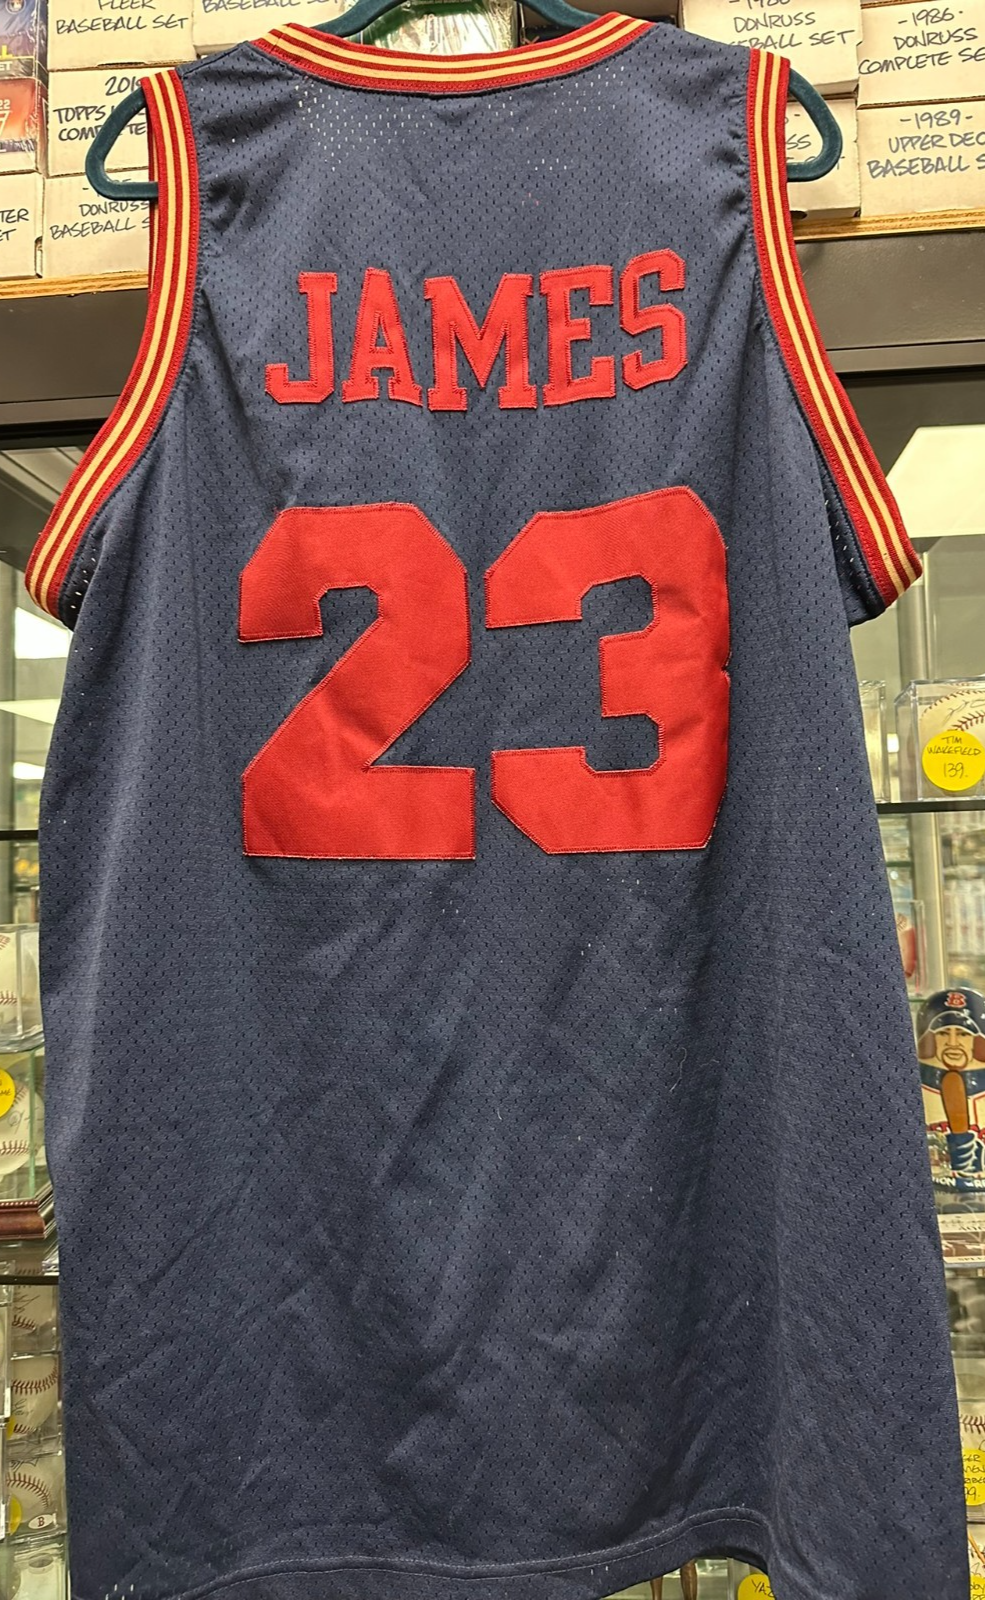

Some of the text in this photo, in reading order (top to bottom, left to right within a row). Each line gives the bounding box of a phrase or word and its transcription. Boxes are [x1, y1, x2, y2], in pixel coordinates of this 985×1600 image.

[56, 14, 189, 34] BASEBALL SET
[733, 12, 816, 33] DONRUSS
[808, 30, 855, 46] SET
[893, 27, 978, 50] DONRUSS
[858, 51, 952, 74] COMPLETE
[53, 105, 106, 124] TOPPS
[888, 134, 947, 153] UPPER
[866, 155, 970, 179] BASEBALL
[50, 218, 136, 240] BASEBALL
[265, 248, 688, 412] JAMES
[238, 486, 732, 860] 23
[927, 745, 981, 756] WAKEFIELD
[941, 736, 962, 744] TIM
